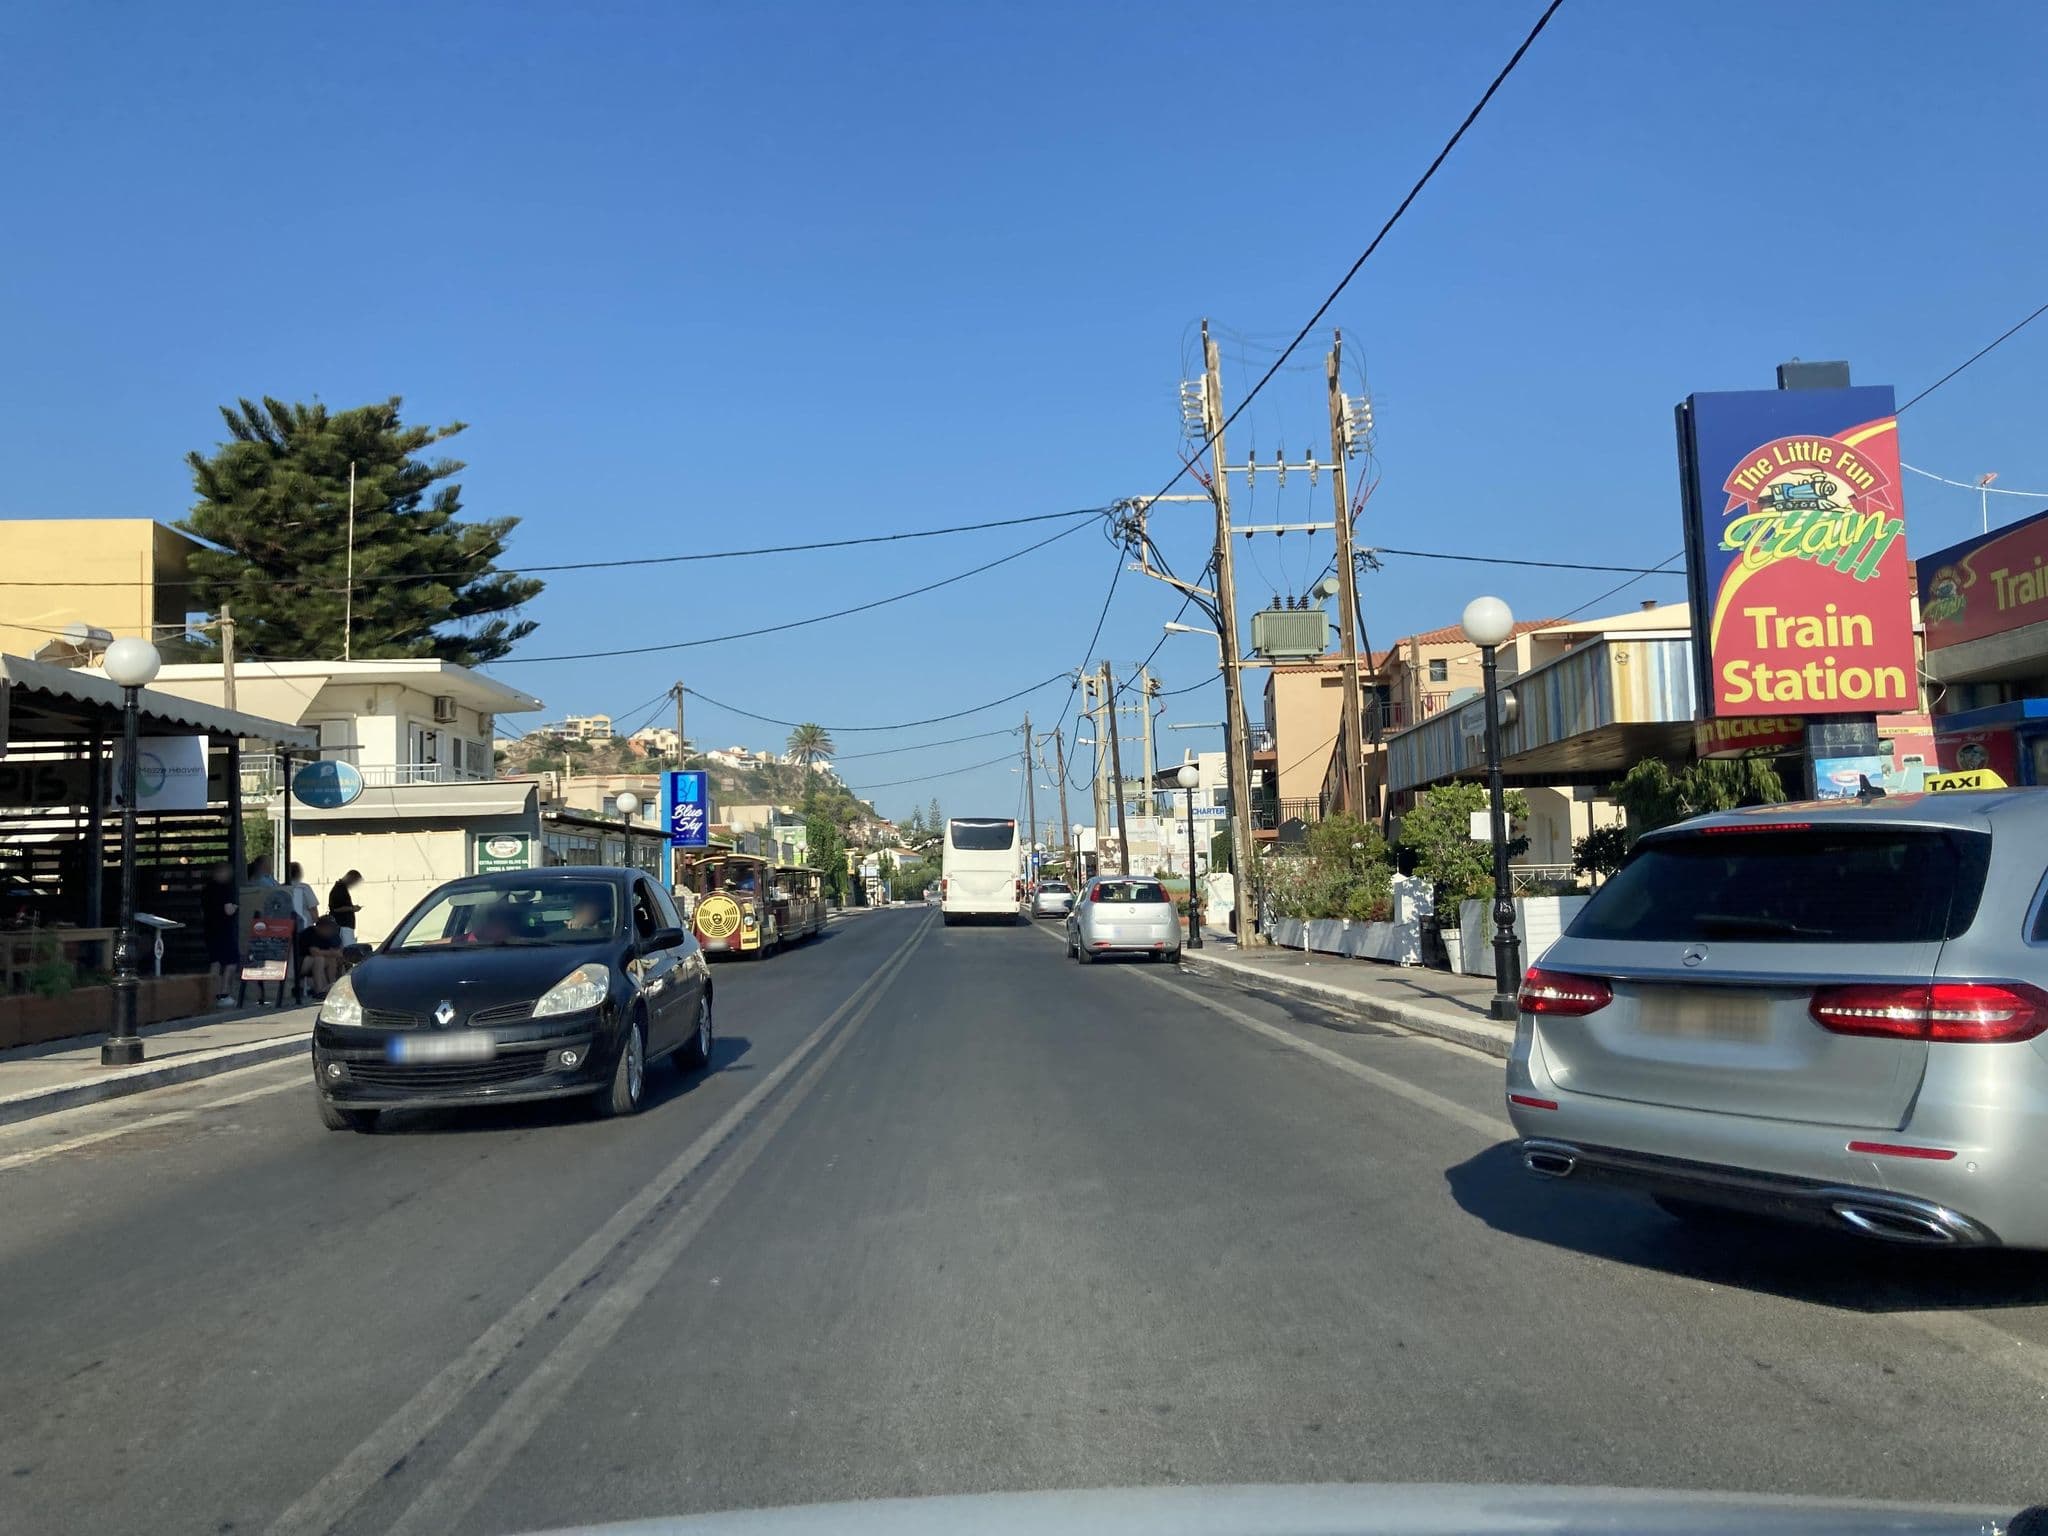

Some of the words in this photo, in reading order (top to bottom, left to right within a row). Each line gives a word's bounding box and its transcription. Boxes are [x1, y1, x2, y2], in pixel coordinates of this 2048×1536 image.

[1733, 457, 1774, 491] The
[1773, 441, 1833, 466] Little
[1836, 451, 1875, 490] Fun
[1723, 510, 1888, 570] Train
[1743, 603, 1873, 649] Train
[1722, 656, 1906, 703] Station
[1928, 775, 1981, 792] TAXI
[671, 803, 703, 819] Blue
[675, 817, 703, 835] Sky
[1192, 807, 1225, 815] CHARTER
